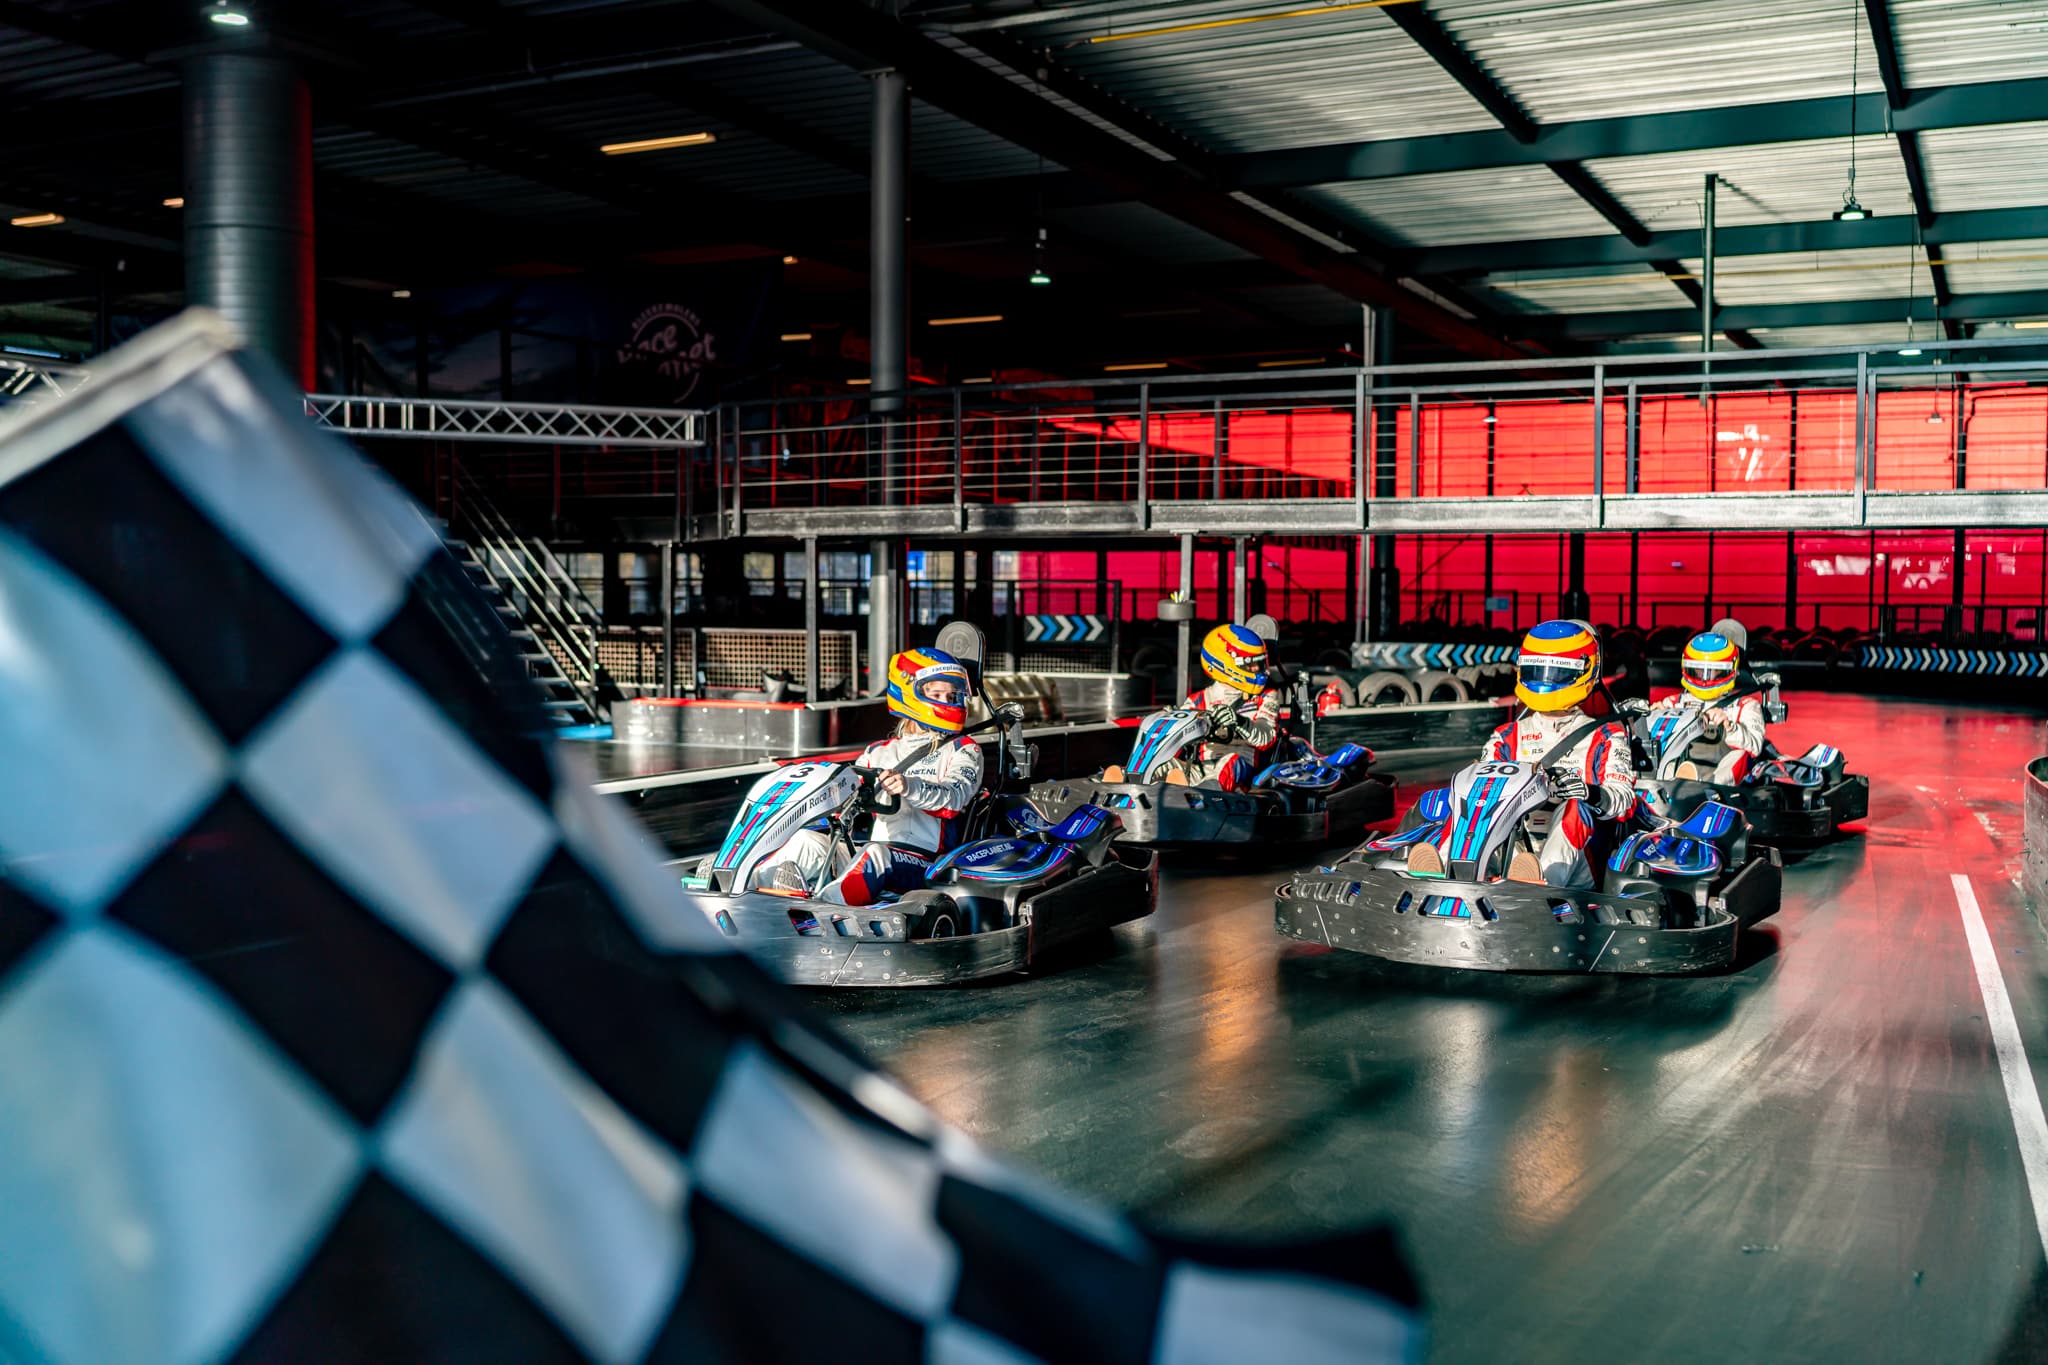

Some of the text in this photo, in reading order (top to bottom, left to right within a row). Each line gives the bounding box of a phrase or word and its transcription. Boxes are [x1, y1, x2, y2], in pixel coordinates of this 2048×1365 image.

[789, 766, 815, 778] 3
[903, 768, 937, 776] ANET.NL
[1475, 765, 1520, 775] 30
[1523, 786, 1536, 801] Race
[808, 792, 827, 809] Race
[891, 850, 933, 869] RACEPLA
